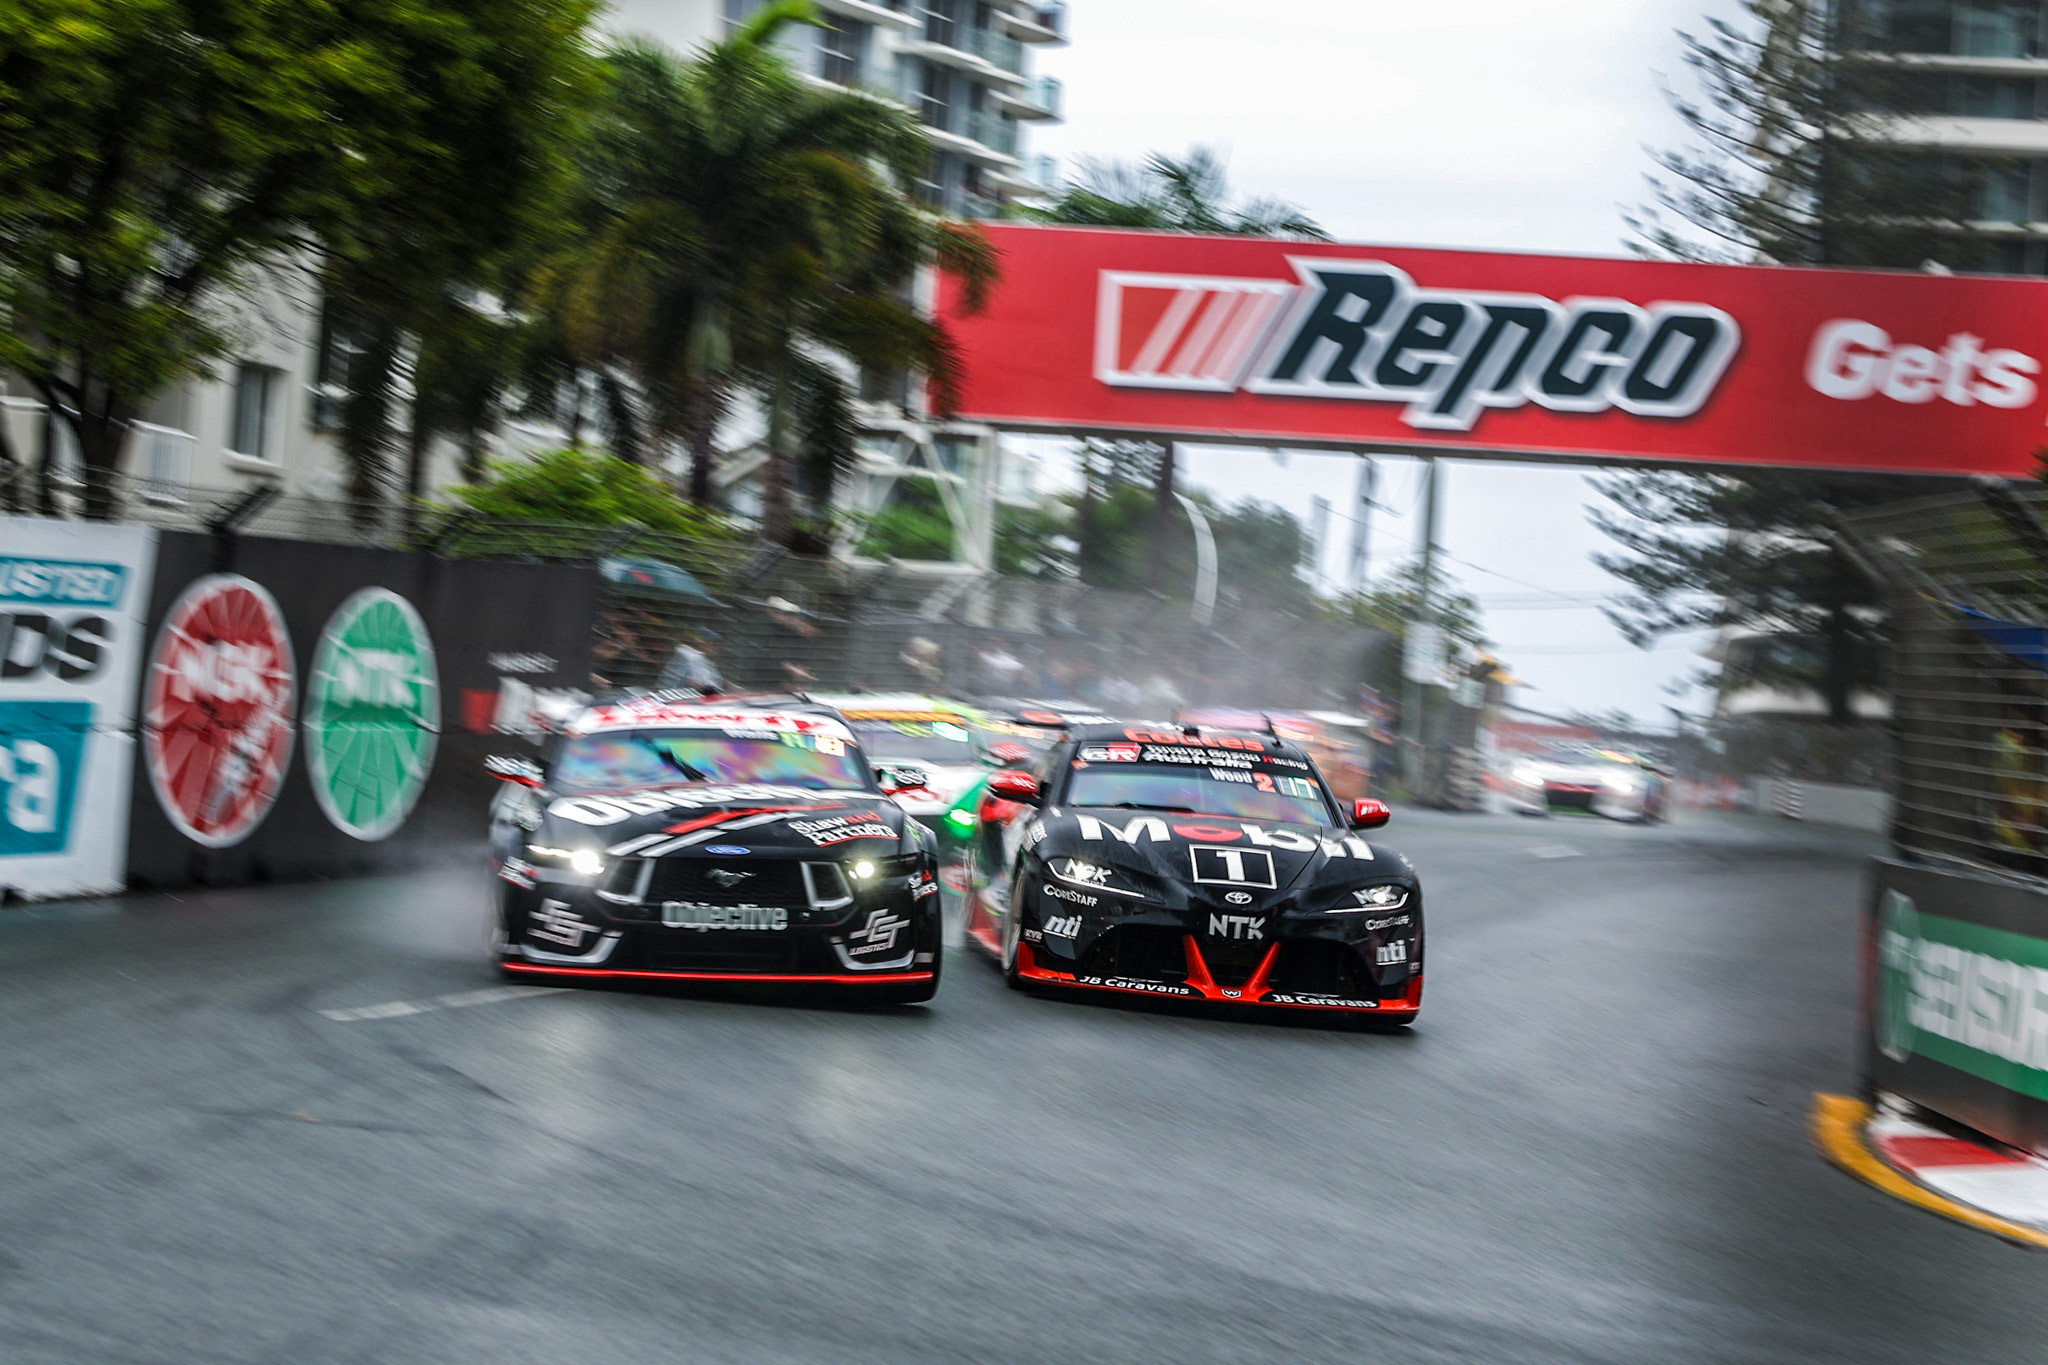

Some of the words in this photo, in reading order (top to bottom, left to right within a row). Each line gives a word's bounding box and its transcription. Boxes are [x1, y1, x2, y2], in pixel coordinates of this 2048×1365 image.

[1258, 260, 1736, 426] Repco
[1803, 318, 2041, 408] Gets
[1208, 767, 1253, 784] Wood
[1252, 772, 1277, 793] 2
[788, 815, 848, 834] Shaw
[805, 823, 898, 846] Partners
[1075, 814, 1375, 861] Mobil
[1216, 849, 1245, 882] 1
[1044, 915, 1083, 937] nti
[1209, 912, 1267, 939] NTK
[1079, 975, 1102, 985] JB
[1104, 978, 1190, 995] Caravans
[1272, 993, 1295, 1003] JB
[1295, 996, 1378, 1008] Caravans
